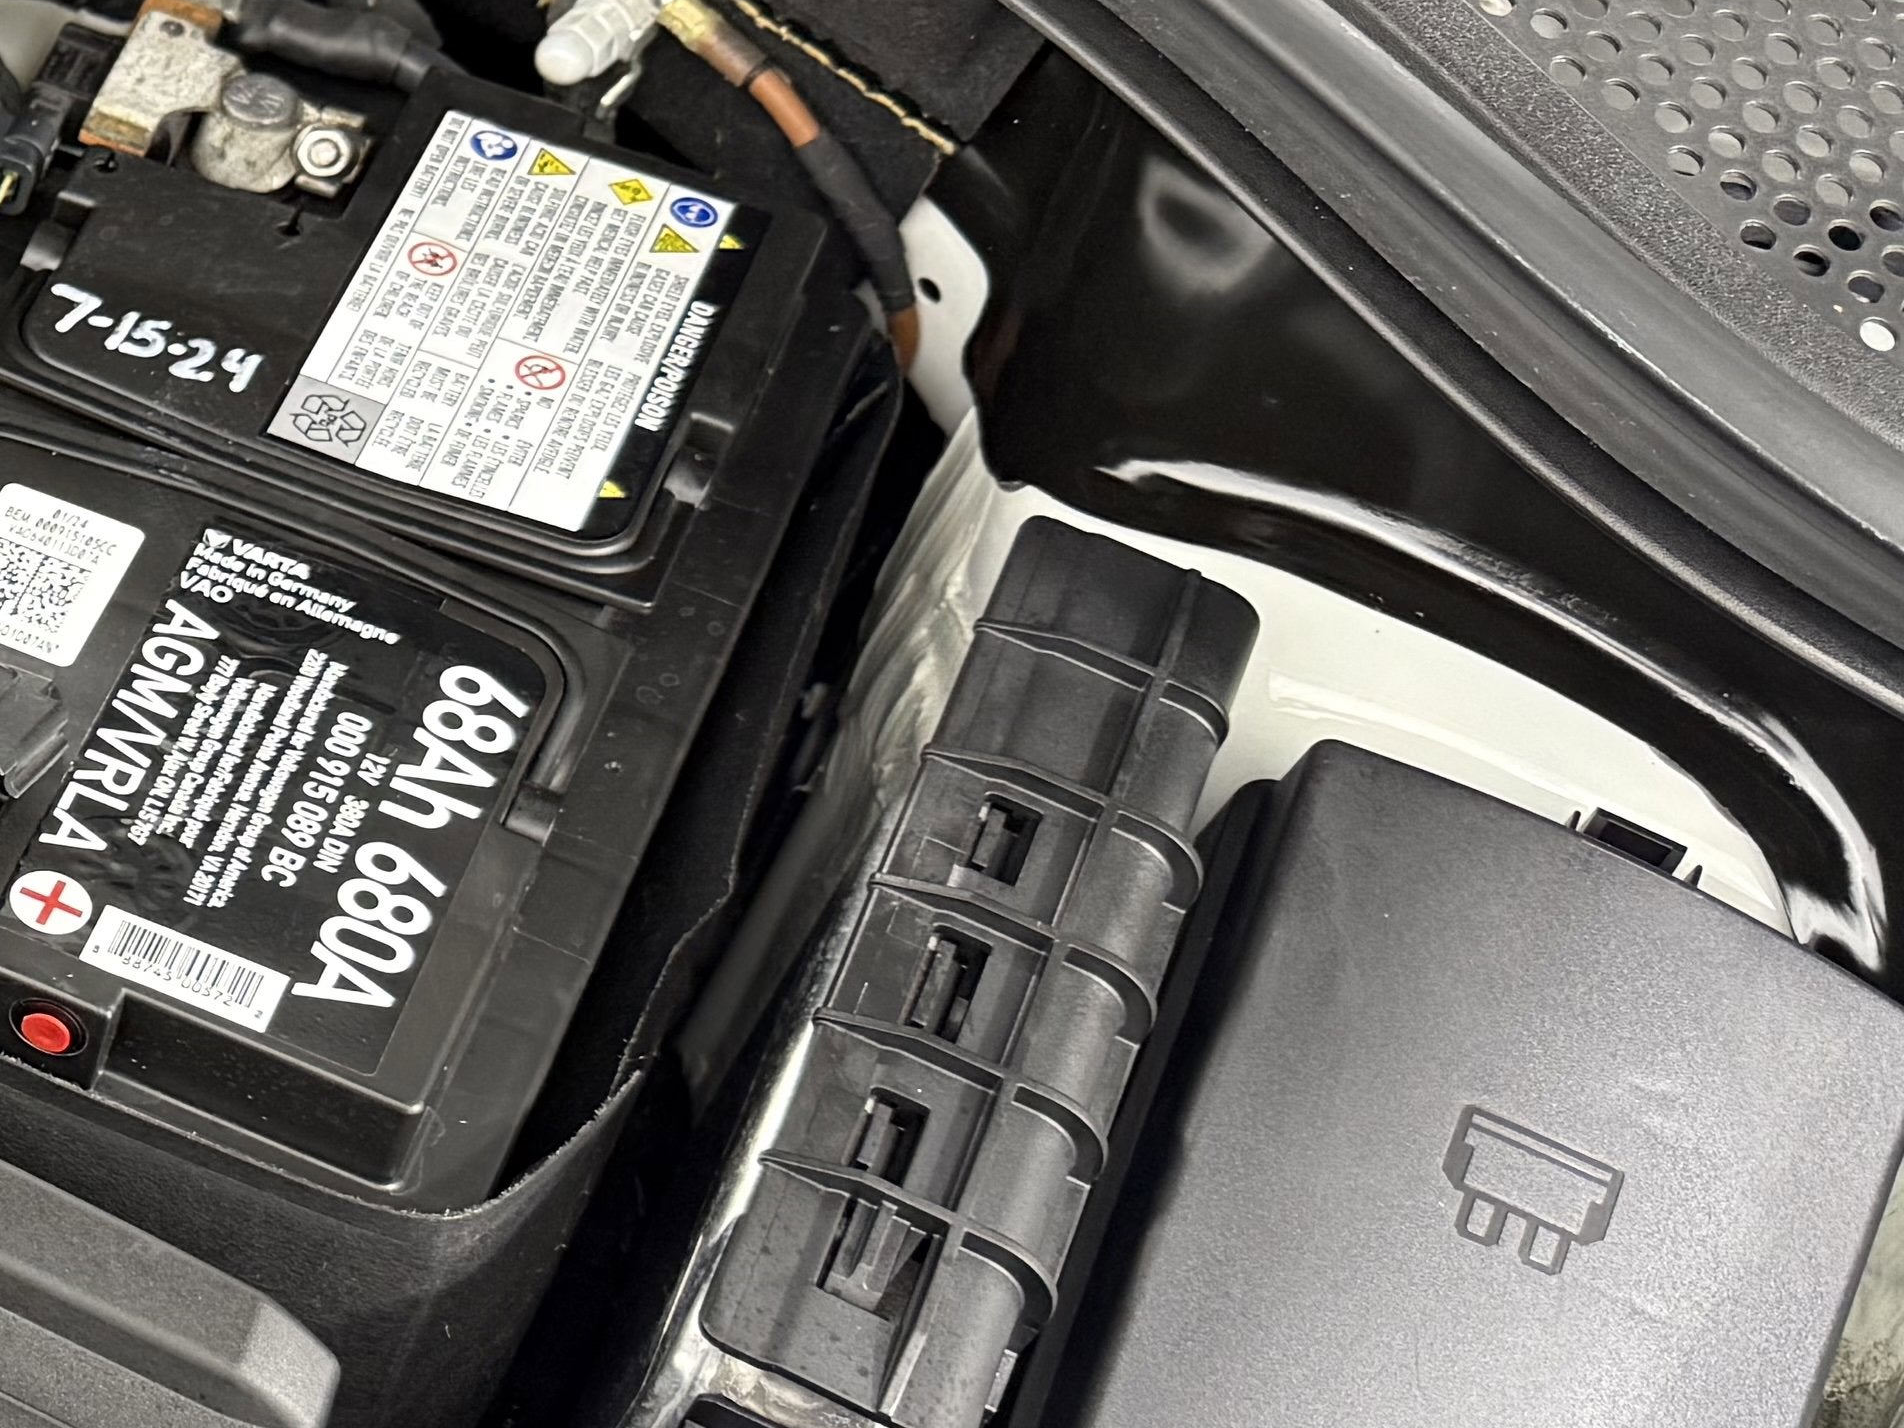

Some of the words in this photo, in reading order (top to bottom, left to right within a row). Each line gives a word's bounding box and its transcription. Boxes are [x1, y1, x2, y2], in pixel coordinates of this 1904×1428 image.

[637, 293, 658, 311] CAN
[50, 283, 265, 393] 7-15-24
[428, 365, 451, 391] MUST
[602, 364, 623, 381] LES
[633, 300, 716, 431] DANGER/POISON
[419, 389, 438, 402] BE
[536, 396, 555, 409] NO
[427, 422, 443, 434] LA
[602, 411, 621, 429] LES
[470, 434, 490, 450] LES
[489, 440, 509, 457] LES
[193, 542, 245, 572] Made
[246, 565, 267, 580] in
[267, 571, 358, 613] Germany
[232, 538, 311, 580] VARTA
[180, 570, 234, 603] VAO
[185, 556, 270, 599] Fabriqué
[269, 591, 297, 608] en
[295, 601, 402, 645] Allemagne
[213, 654, 240, 678] 777
[194, 672, 230, 705] Bayly
[271, 674, 315, 729] Woodland
[295, 660, 349, 734] Manufactured
[37, 598, 221, 851] AGM/VRLA
[180, 701, 215, 738] Street
[202, 676, 256, 740] Volkswagen
[224, 681, 279, 757] Manufactured
[254, 724, 290, 761] Pointe
[288, 730, 313, 753] for
[323, 711, 373, 757] 000
[377, 664, 530, 829] 68Ah
[159, 747, 189, 778] Ajax
[186, 738, 222, 773] Group
[356, 752, 391, 786] 12V
[166, 771, 205, 816] Canada
[255, 748, 305, 814] Volkswagen
[301, 755, 351, 804] 915
[178, 816, 204, 849] pour
[235, 811, 272, 848] Group
[280, 800, 329, 848] 089
[327, 794, 370, 837] 380A
[198, 854, 225, 872] VA
[231, 845, 252, 863] of
[260, 845, 307, 887] BC
[312, 836, 350, 873] DIN
[182, 869, 216, 906] 20171
[290, 840, 447, 1008] 680A
[180, 975, 234, 1007] 00572
